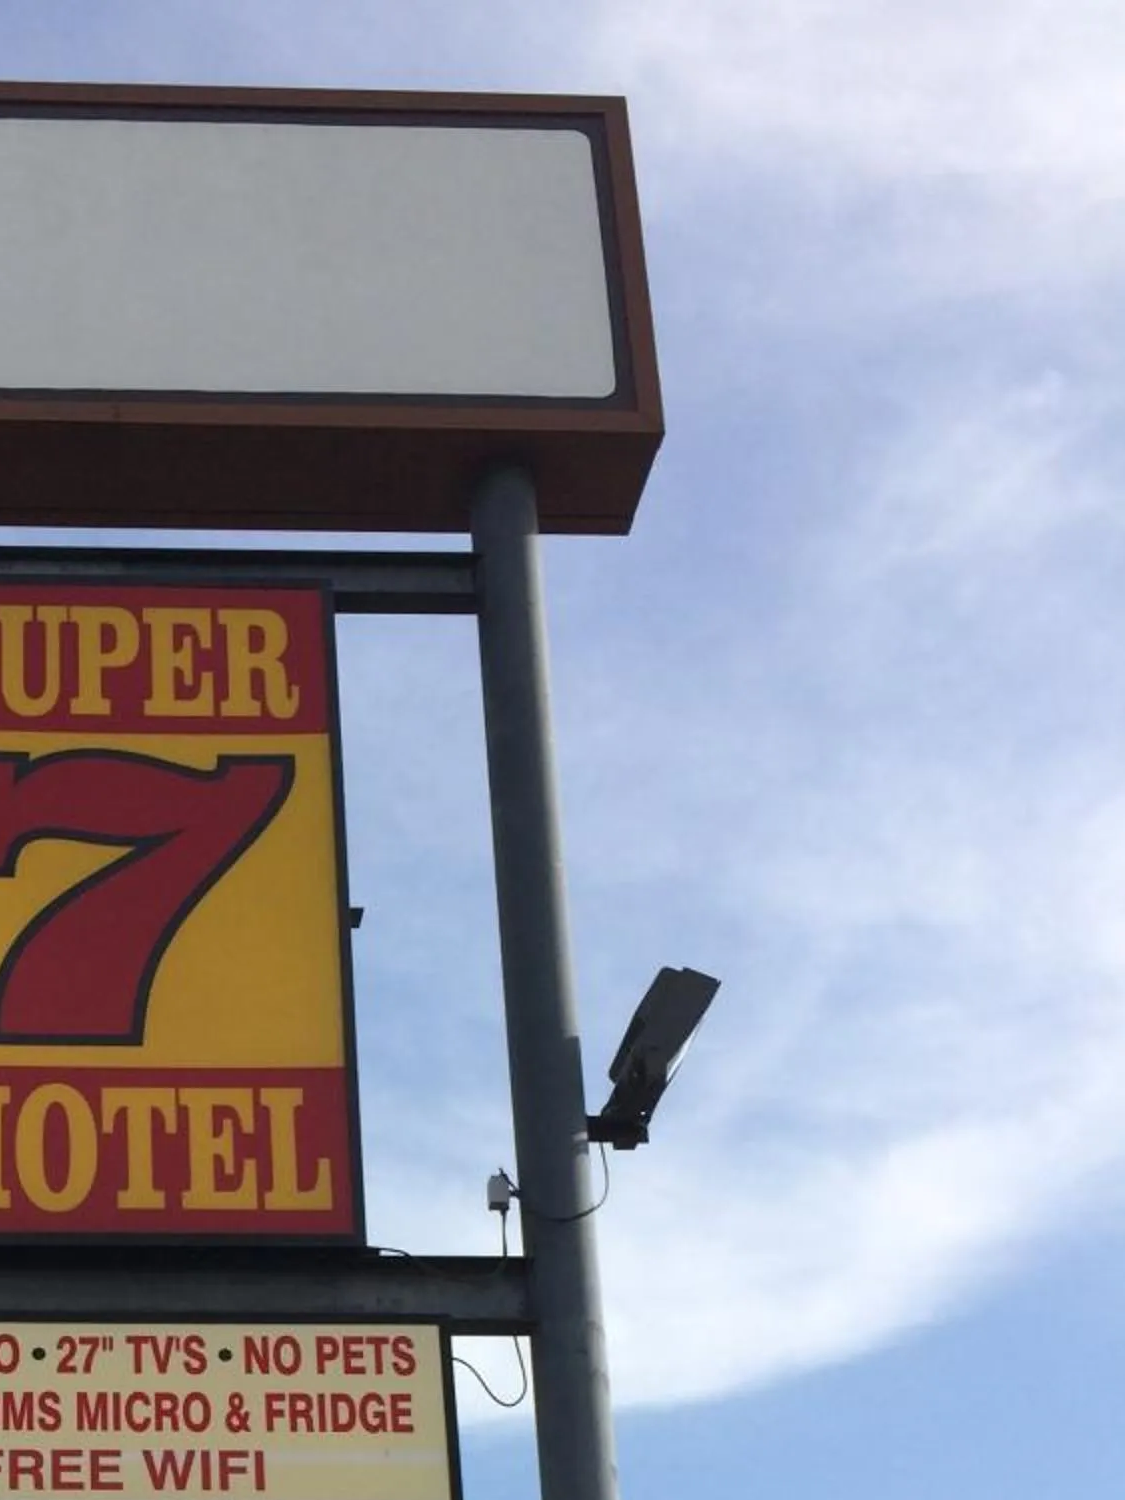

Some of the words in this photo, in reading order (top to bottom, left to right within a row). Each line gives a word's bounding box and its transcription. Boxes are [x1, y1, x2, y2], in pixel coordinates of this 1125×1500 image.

[56, 1336, 116, 1375] 27"
[125, 1335, 208, 1375] TV'S
[244, 1336, 302, 1376] NO
[316, 1336, 416, 1376] PETS
[76, 1391, 212, 1432] MICRO
[224, 1392, 250, 1433] &
[265, 1392, 415, 1434] FRIDGE
[142, 1450, 266, 1491] WIFI
